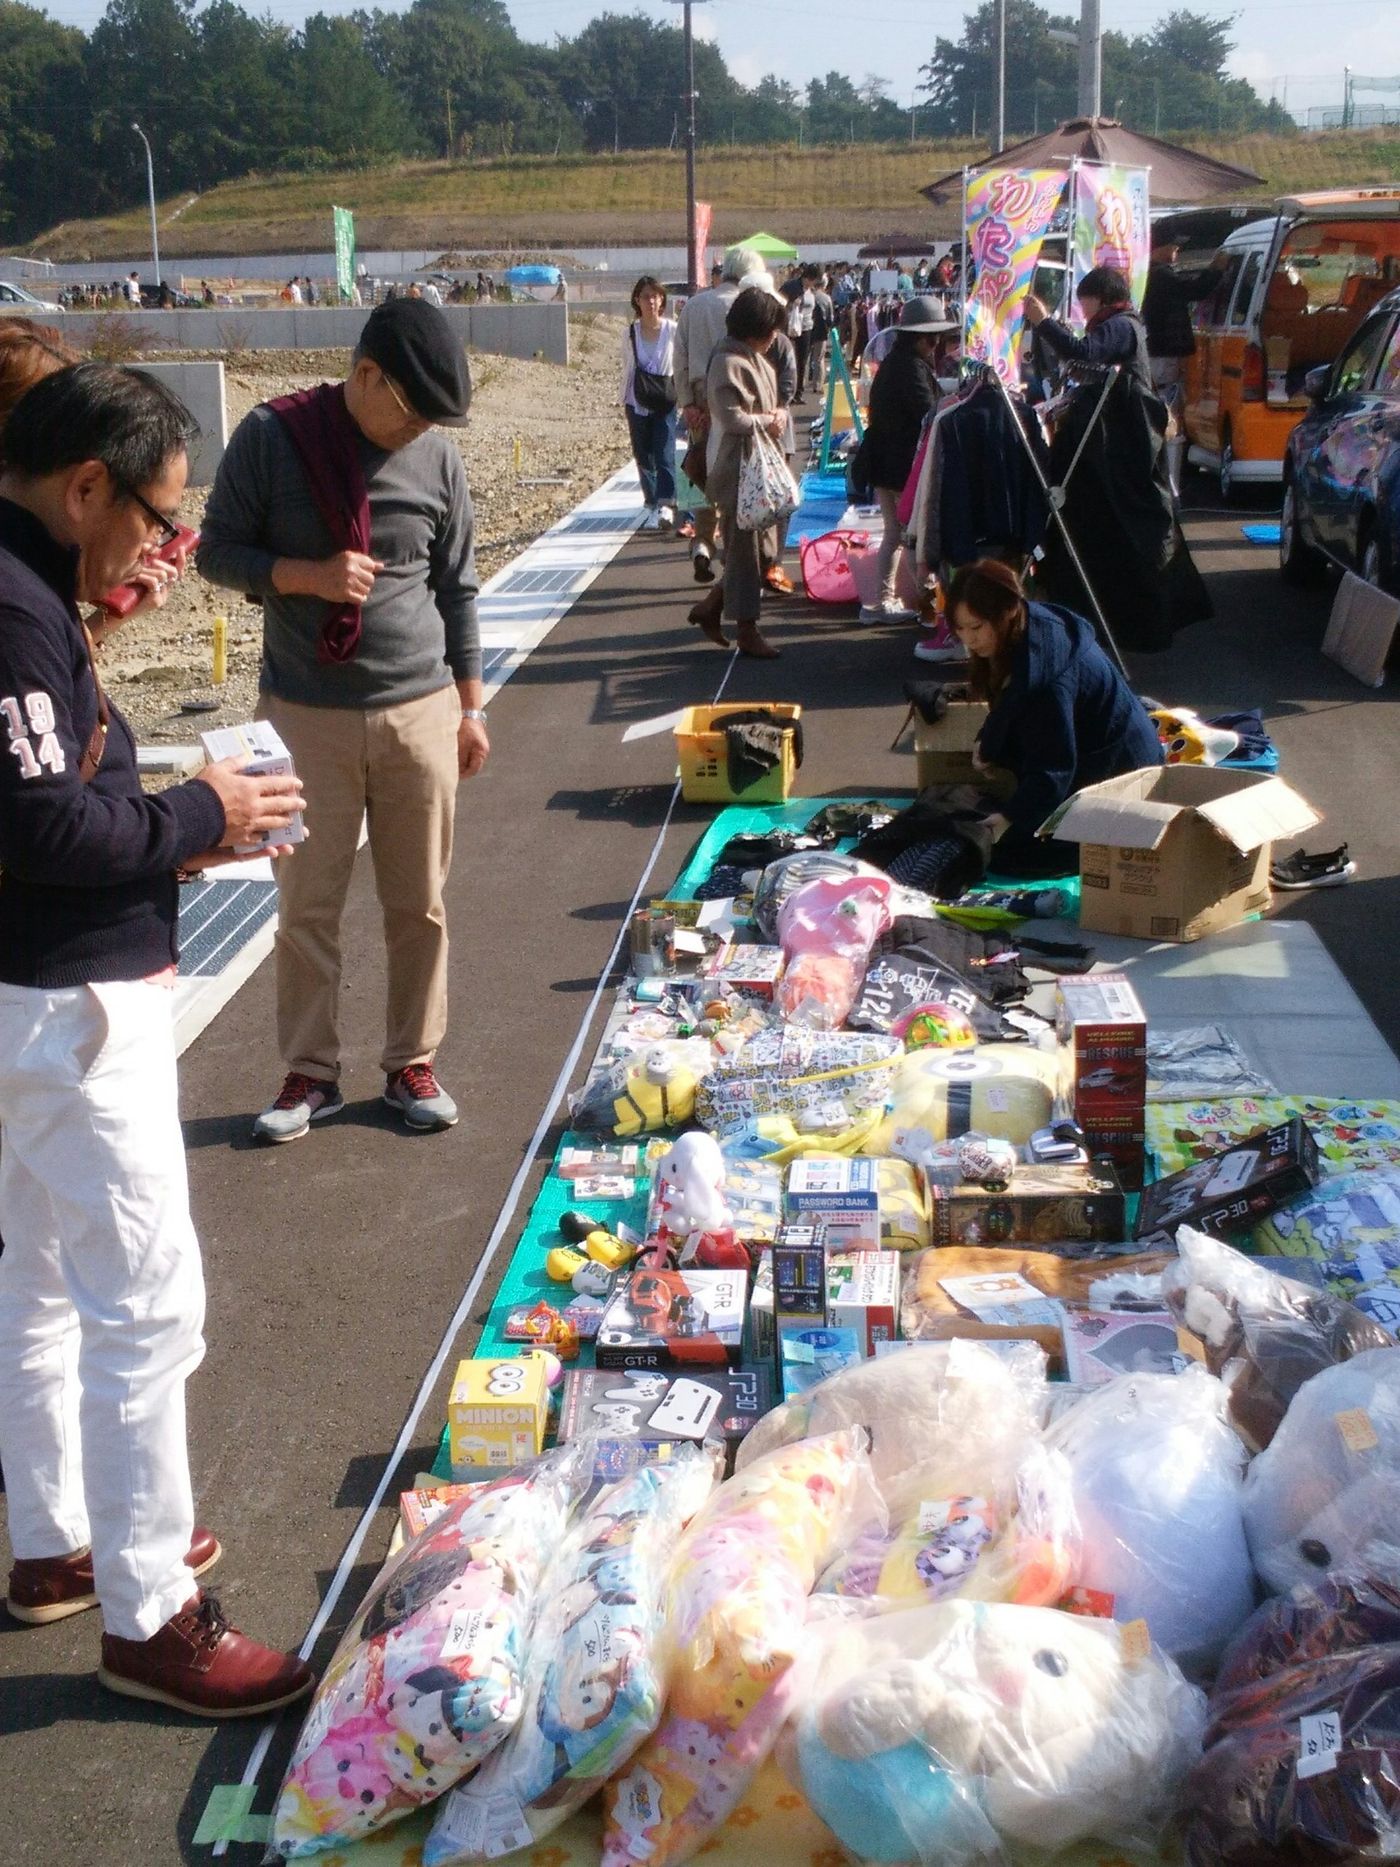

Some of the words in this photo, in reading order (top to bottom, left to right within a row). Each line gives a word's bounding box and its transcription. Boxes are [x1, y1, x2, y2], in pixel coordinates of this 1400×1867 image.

[0, 693, 55, 739] 19
[10, 733, 65, 778] 14
[798, 1198, 844, 1207] PASSWORD
[845, 1197, 869, 1206] BANK
[456, 1407, 533, 1424] MINION
[584, 1640, 597, 1658] 500
